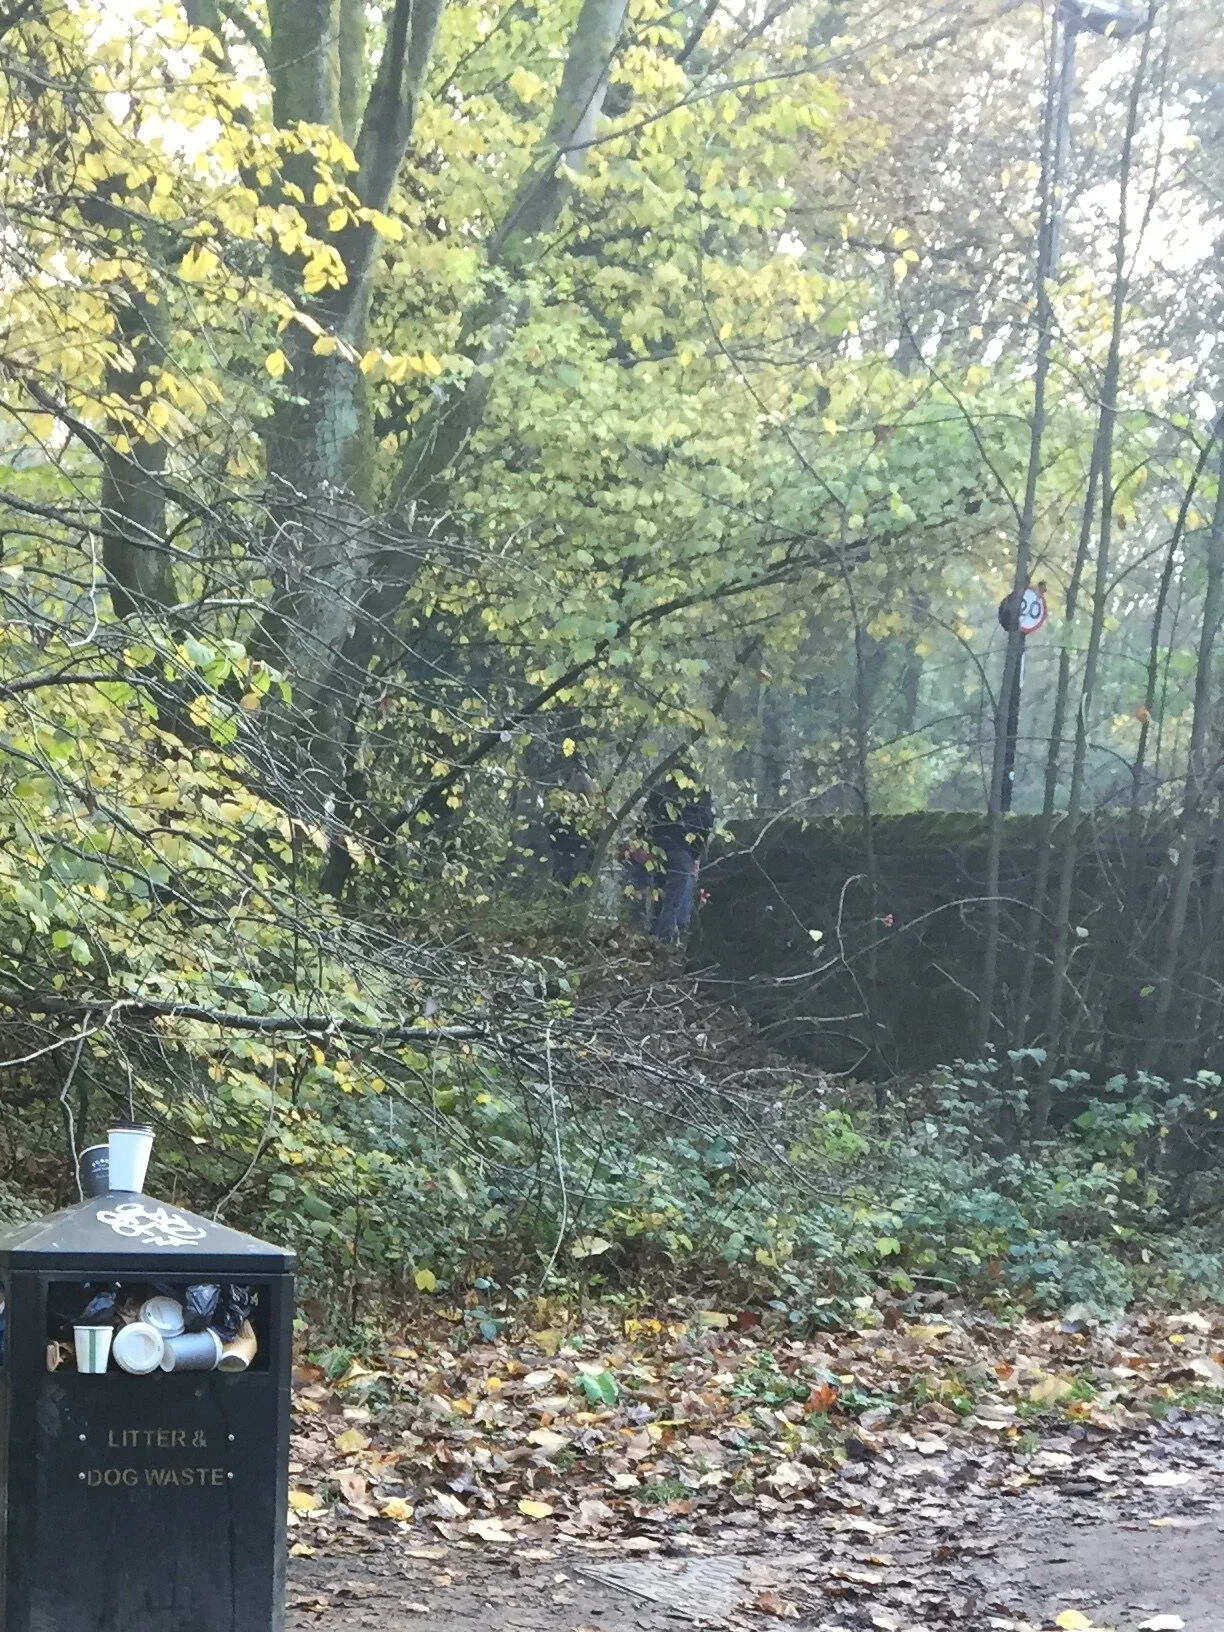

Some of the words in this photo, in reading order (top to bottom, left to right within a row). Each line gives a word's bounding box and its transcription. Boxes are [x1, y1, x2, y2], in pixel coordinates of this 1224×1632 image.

[108, 1429, 186, 1448] LITTER
[191, 1429, 208, 1448] &
[87, 1468, 138, 1487] DOG
[144, 1467, 224, 1487] WASTE
